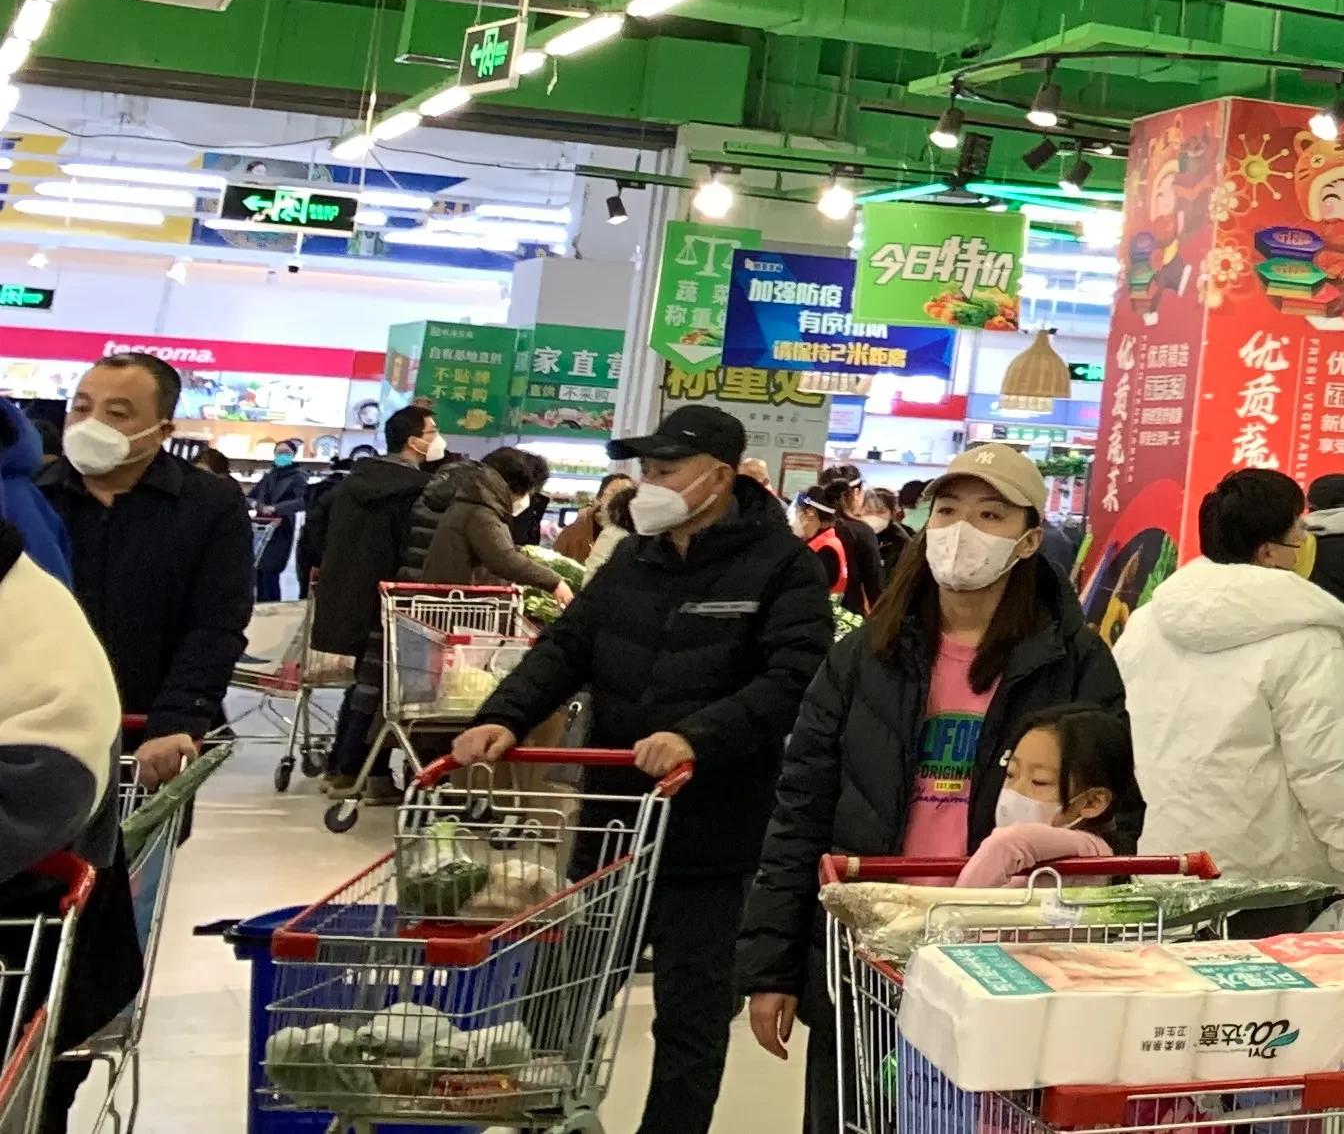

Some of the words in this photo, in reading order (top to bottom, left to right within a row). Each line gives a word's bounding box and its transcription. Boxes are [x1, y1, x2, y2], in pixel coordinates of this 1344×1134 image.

[868, 235, 1015, 299] 今日特价
[748, 278, 844, 309] 加强防疫
[664, 304, 727, 332] 称重
[772, 340, 908, 368] 请保持2米距离
